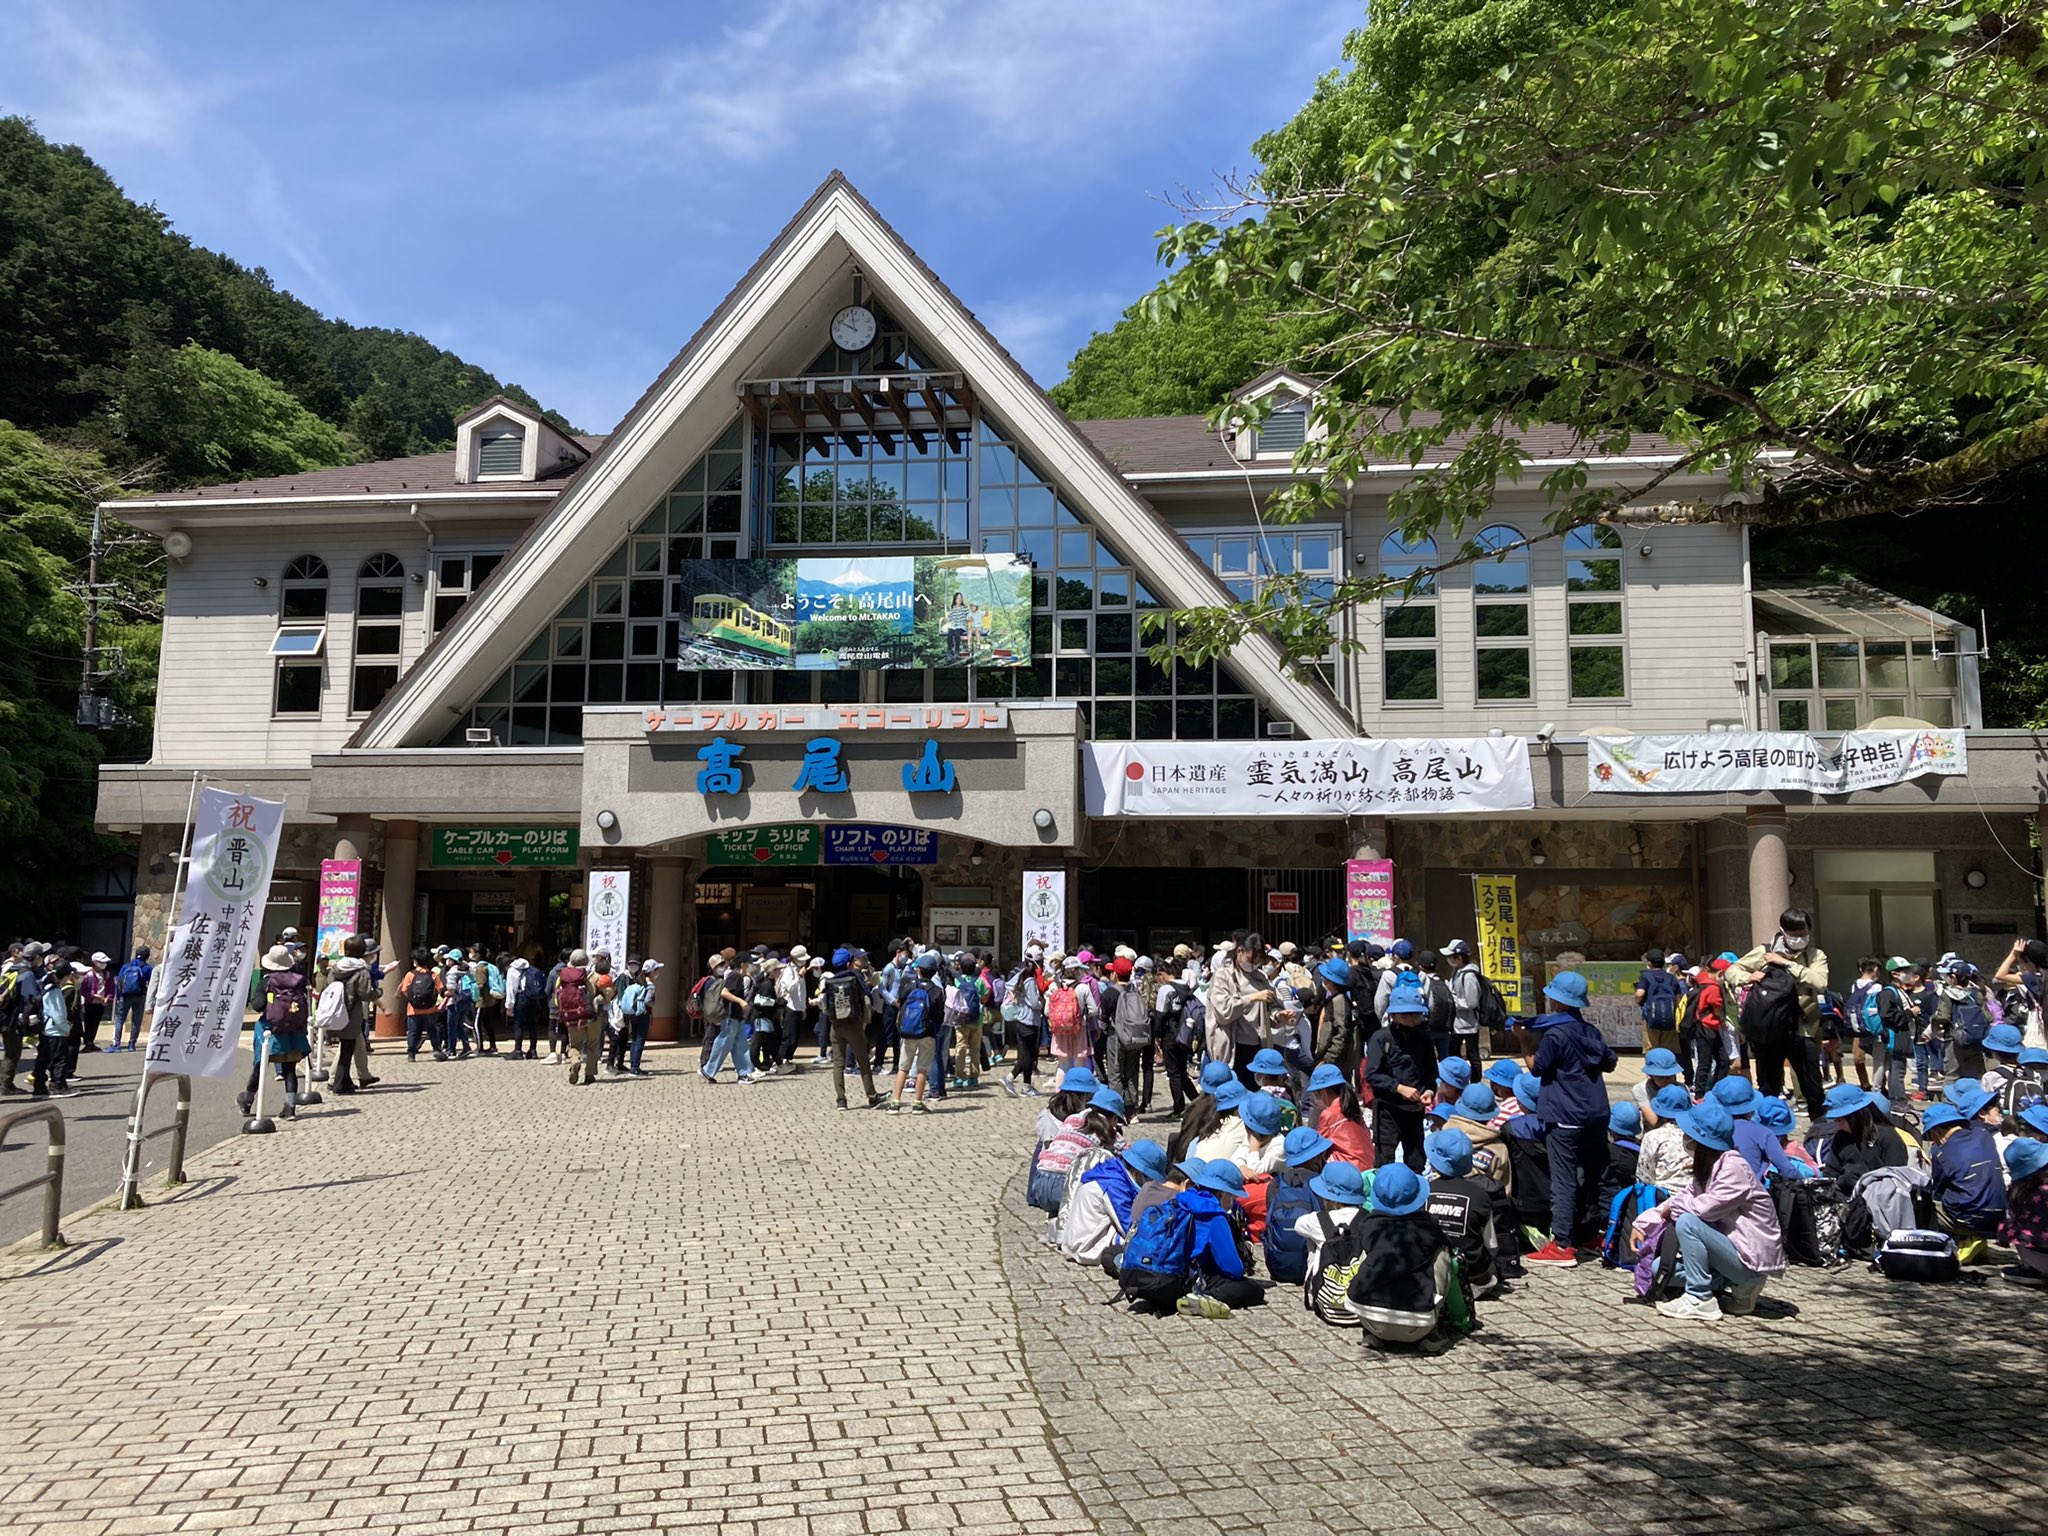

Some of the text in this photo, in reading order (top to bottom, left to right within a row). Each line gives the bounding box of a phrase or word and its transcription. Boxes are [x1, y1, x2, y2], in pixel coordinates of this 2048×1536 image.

[780, 591, 932, 611] ようこそ！高尾山へ
[810, 613, 847, 622] Welcome
[859, 612, 901, 621] Mt.TAKAO
[645, 709, 999, 731] ケーブルカー エコーリフト
[1151, 763, 1227, 783] 日本遺産
[1246, 756, 1484, 786] 霊気満山 高尾山
[1151, 786, 1227, 794] JAPAN HERITAGE
[228, 799, 256, 832] 祝
[768, 829, 810, 843] うりば
[831, 830, 931, 845] リフト のりば
[522, 846, 543, 854] PLAT
[545, 846, 569, 854] FORM
[723, 843, 804, 851] TICKET OFFICE
[222, 838, 249, 891] 晋山
[602, 874, 617, 889] 祝
[1036, 875, 1051, 889] 祝
[1482, 885, 1499, 974] スタンプハイク
[146, 912, 212, 1063] 佐藤秀仁僧正
